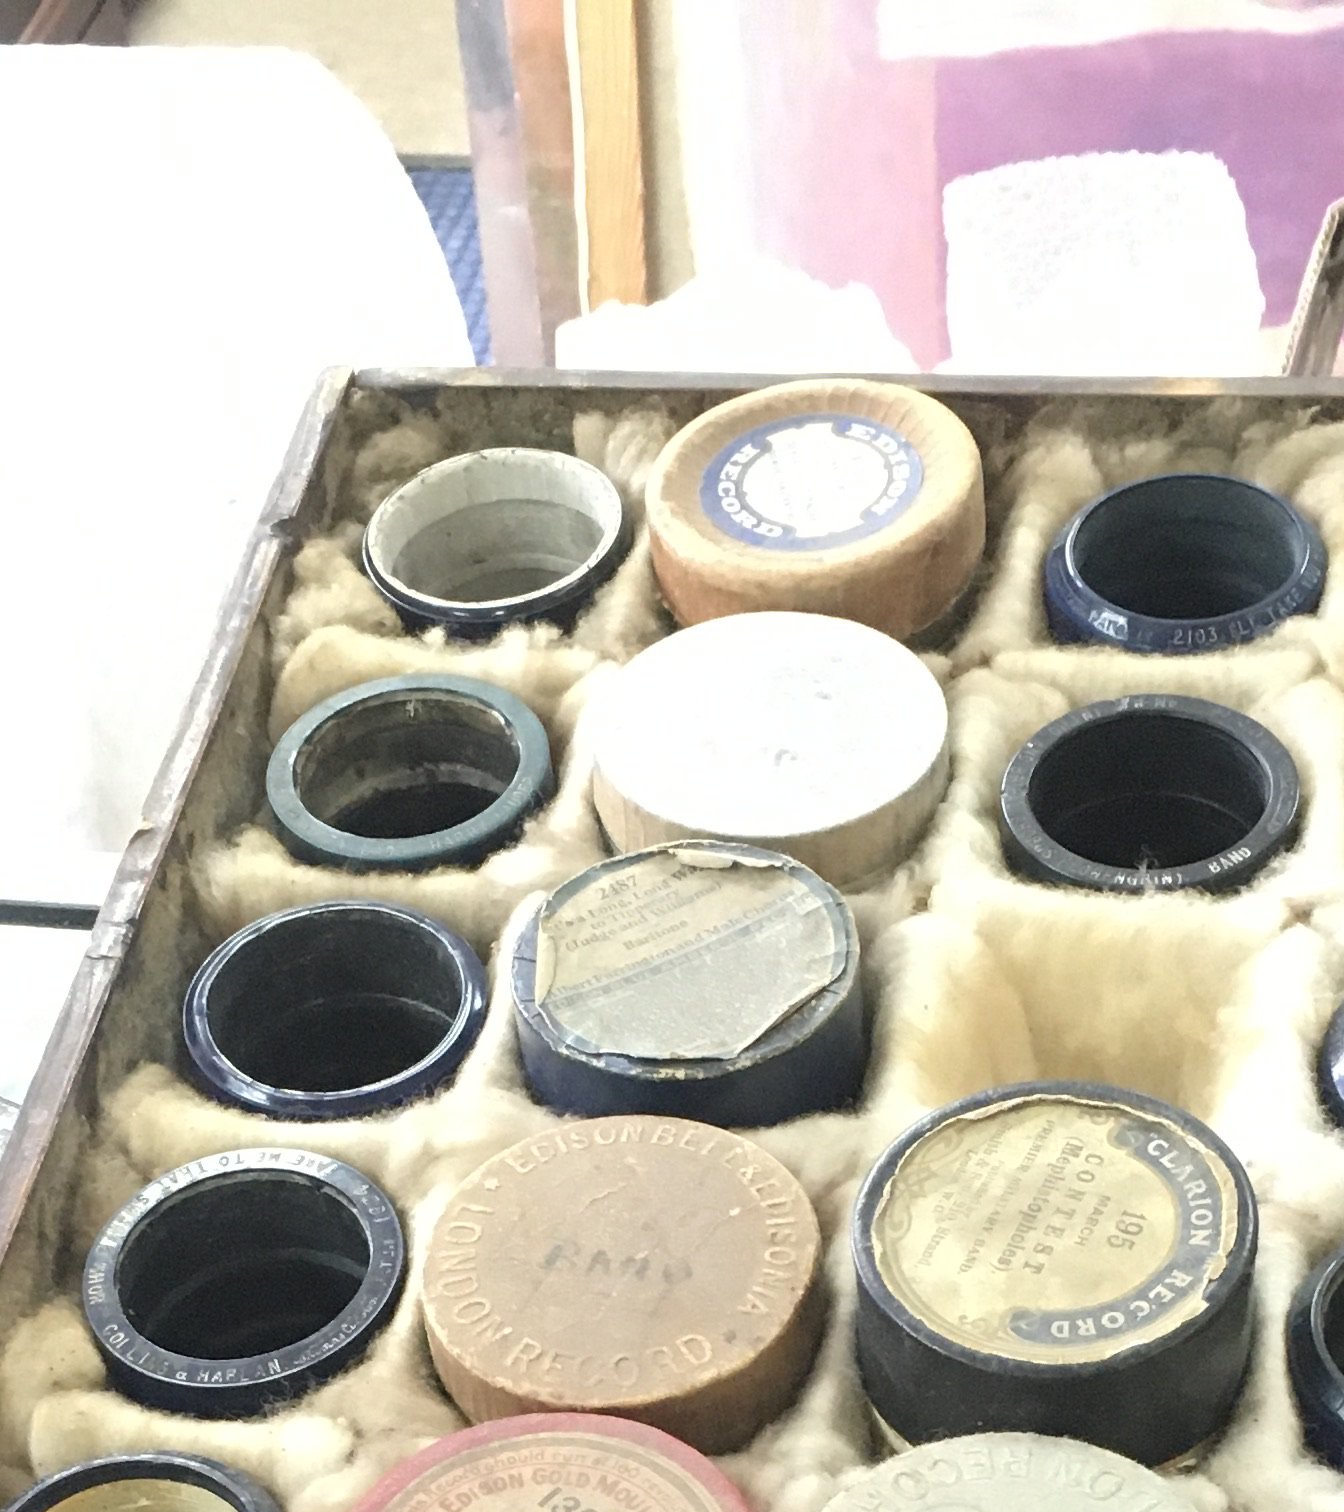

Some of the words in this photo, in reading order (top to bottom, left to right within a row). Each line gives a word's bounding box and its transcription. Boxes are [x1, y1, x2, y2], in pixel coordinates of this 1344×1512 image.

[717, 442, 784, 538] RECORD
[844, 422, 911, 516] EDISON
[1172, 627, 1218, 646] 2103
[597, 874, 639, 901] 2487
[622, 918, 689, 952] Baritone
[1021, 1118, 1057, 1173] PREMIER
[503, 1124, 645, 1174] EDISON
[650, 1124, 743, 1170] BELL
[737, 1180, 798, 1318] EDISONIA
[1022, 1153, 1105, 1276] CONTEST
[1075, 1194, 1112, 1247] MARCH
[1107, 1209, 1147, 1252] 195
[438, 1203, 513, 1342] LONDON
[504, 1333, 714, 1388] RECORD
[1049, 1268, 1194, 1340] RECORD
[530, 1467, 592, 1488] GOLD
